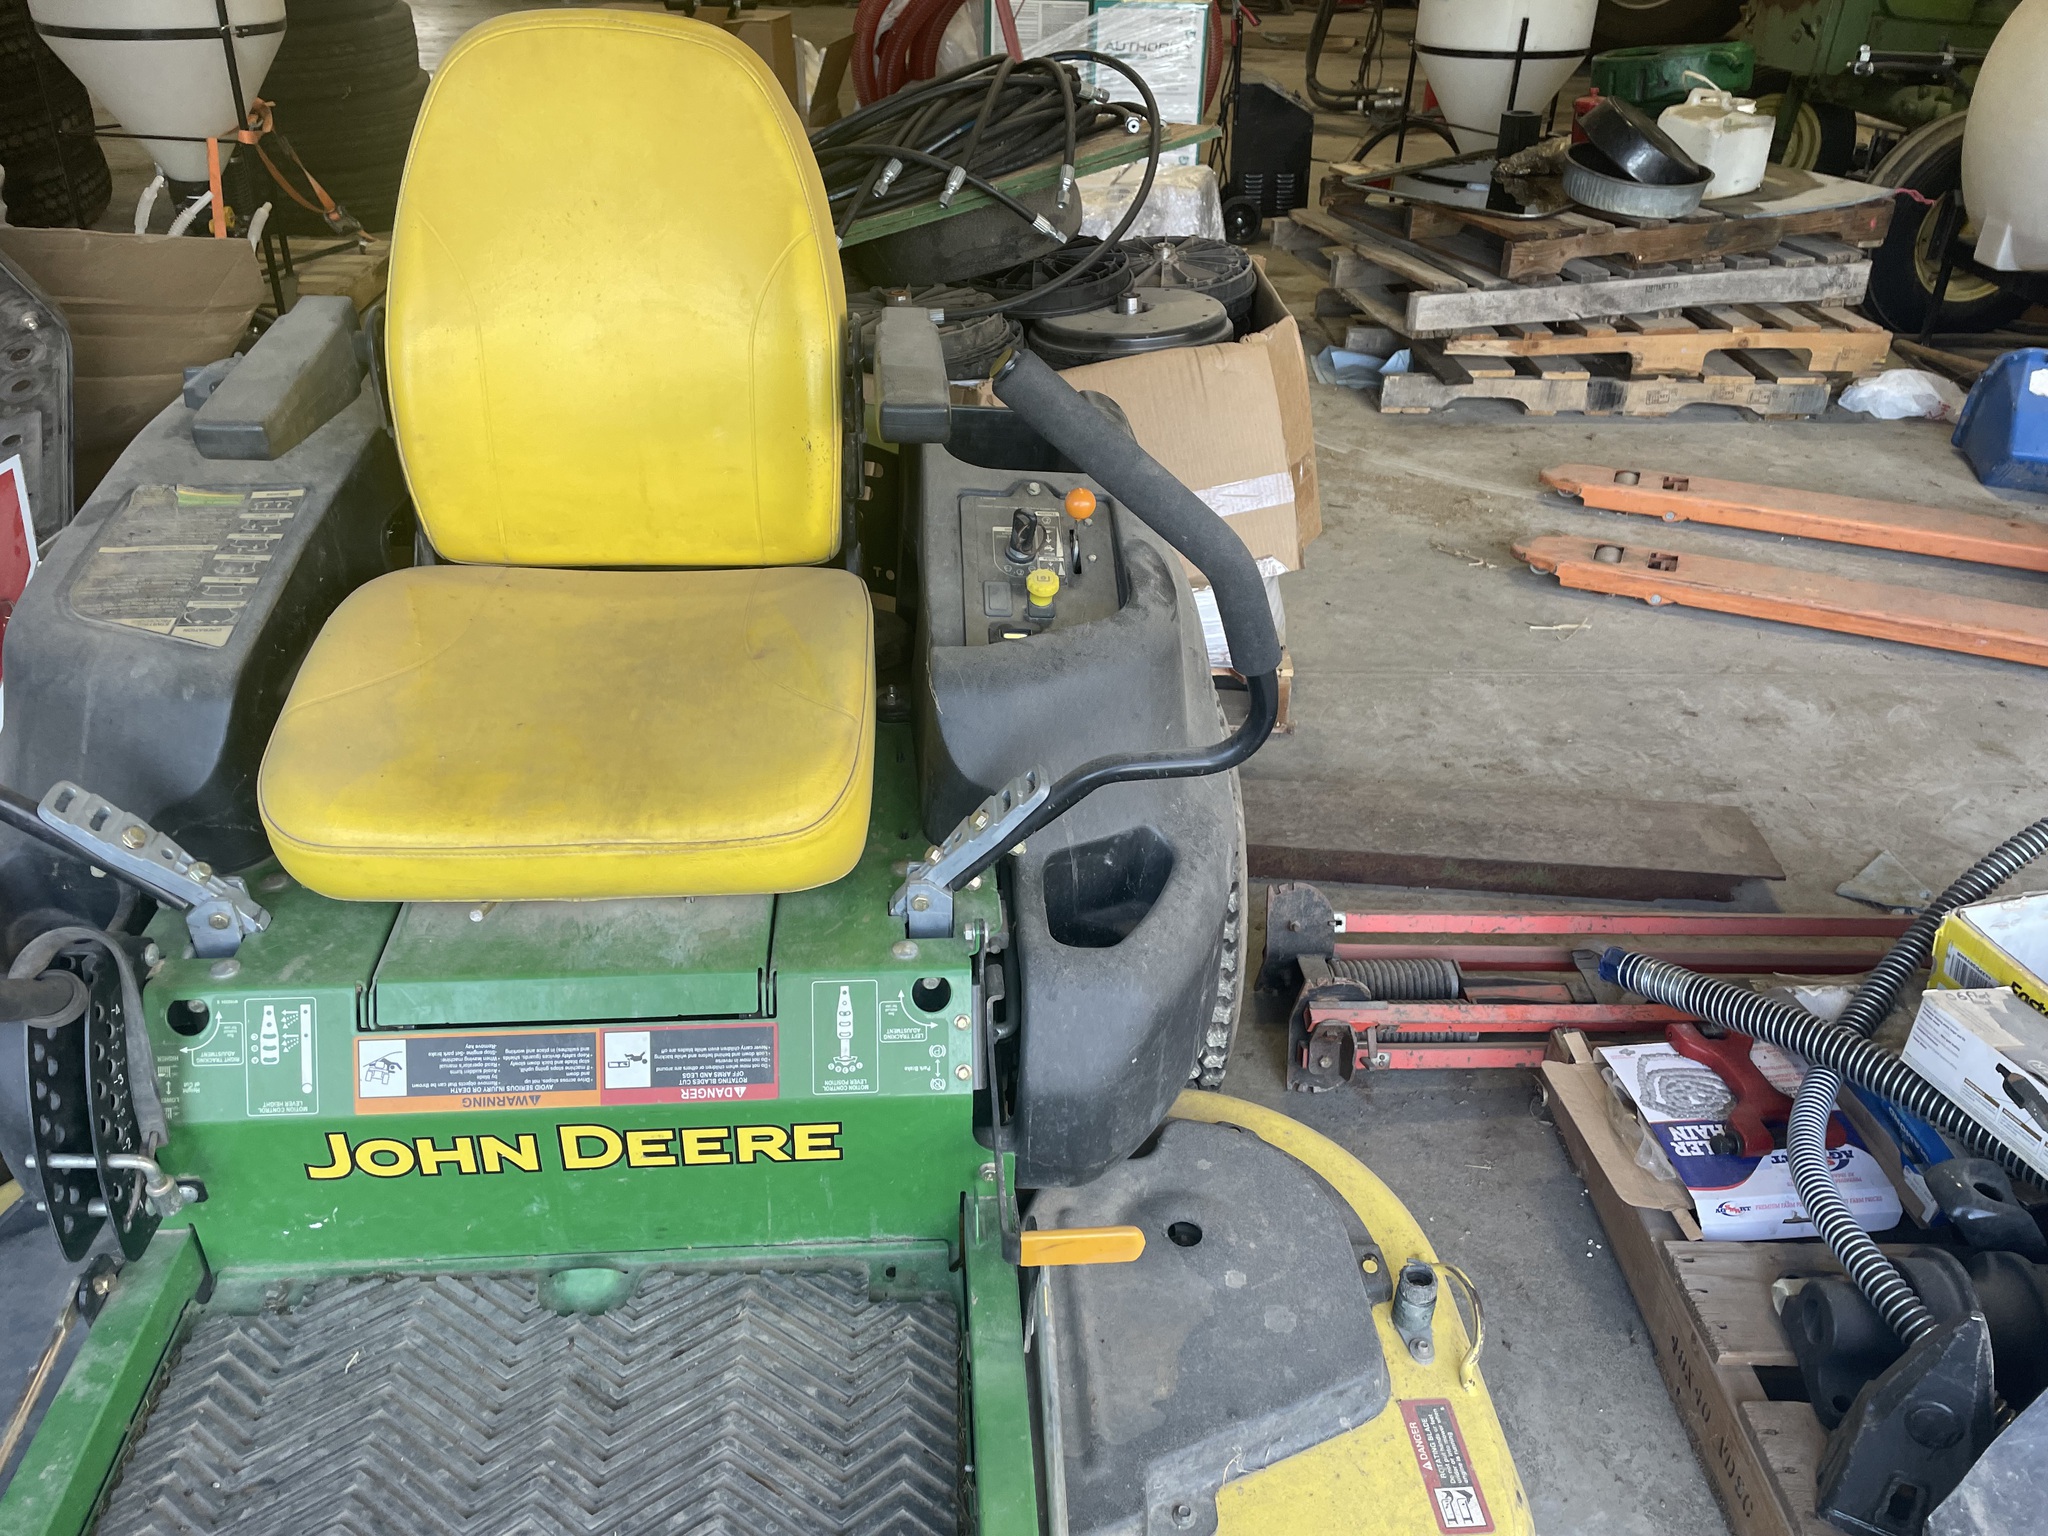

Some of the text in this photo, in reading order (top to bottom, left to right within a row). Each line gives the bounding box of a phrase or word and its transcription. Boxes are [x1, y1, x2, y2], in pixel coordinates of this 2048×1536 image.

[2011, 981, 2048, 1018] Fact
[462, 1096, 528, 1107] WARNING
[681, 1087, 732, 1099] DANGER
[1668, 1124, 1725, 1141] HAIN
[304, 1122, 843, 1180] JOHN DEERE
[1670, 1140, 1714, 1156] LER
[1433, 1408, 1441, 1423] when
[1409, 1422, 1428, 1460] DANGER
[1436, 1433, 1444, 1451] hands
[1439, 1424, 1448, 1444] mower
[1421, 1418, 1446, 1478] ROTATING BLADE
[1448, 1432, 1458, 1454] running
[1441, 1452, 1450, 1463] put
[1450, 1475, 1456, 1484] Do
[1453, 1466, 1462, 1483] under
[1459, 1462, 1468, 1484] engine
